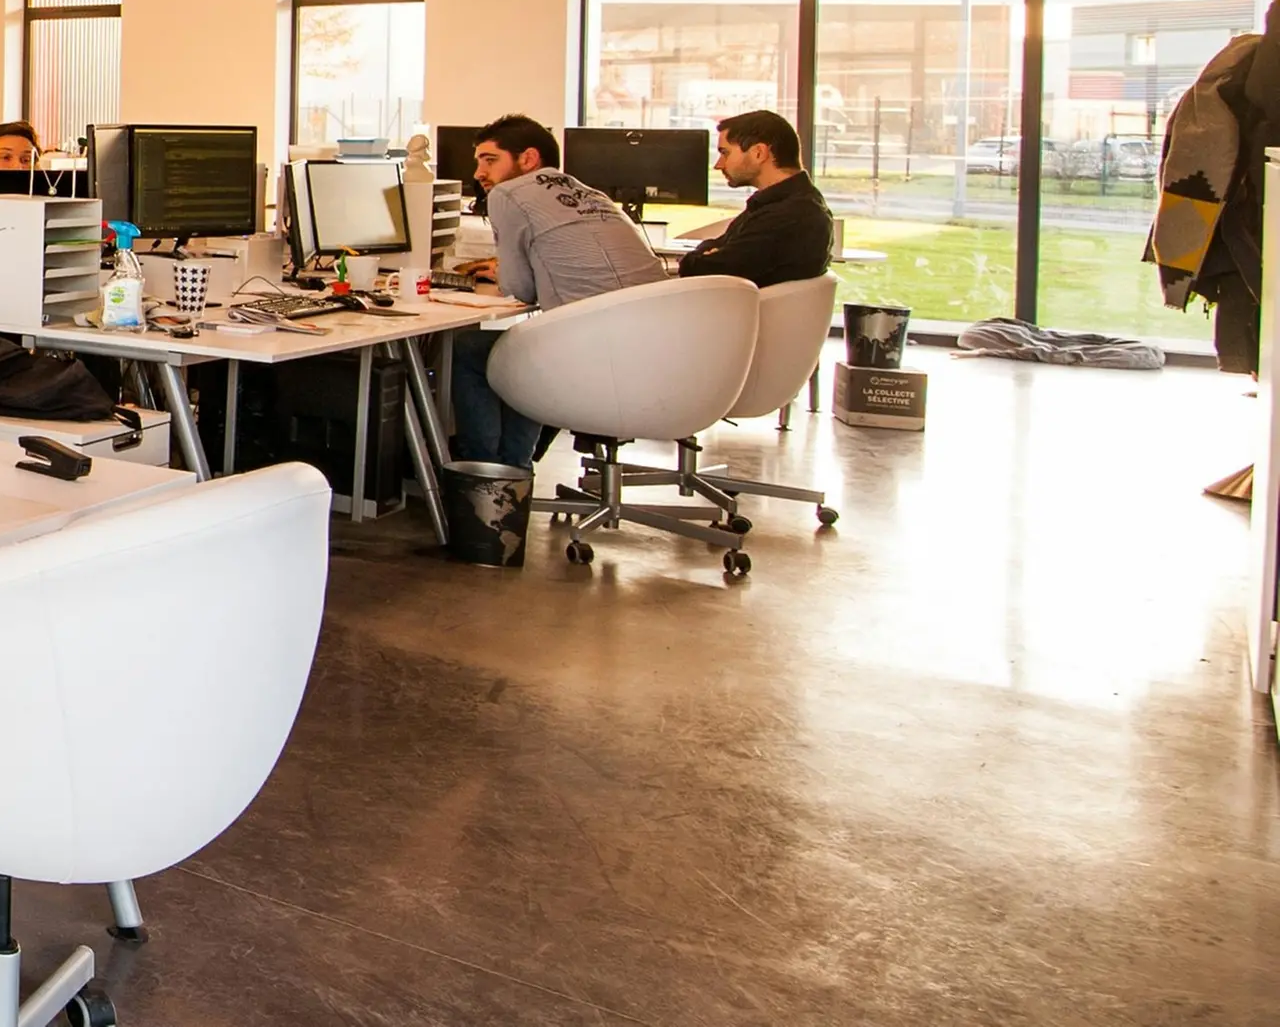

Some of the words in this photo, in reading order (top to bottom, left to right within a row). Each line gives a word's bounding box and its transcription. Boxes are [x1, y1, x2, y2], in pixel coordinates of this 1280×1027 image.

[862, 387, 874, 395] LA
[874, 389, 916, 399] COLLECTE
[867, 395, 911, 406] SÉLECTIVE
